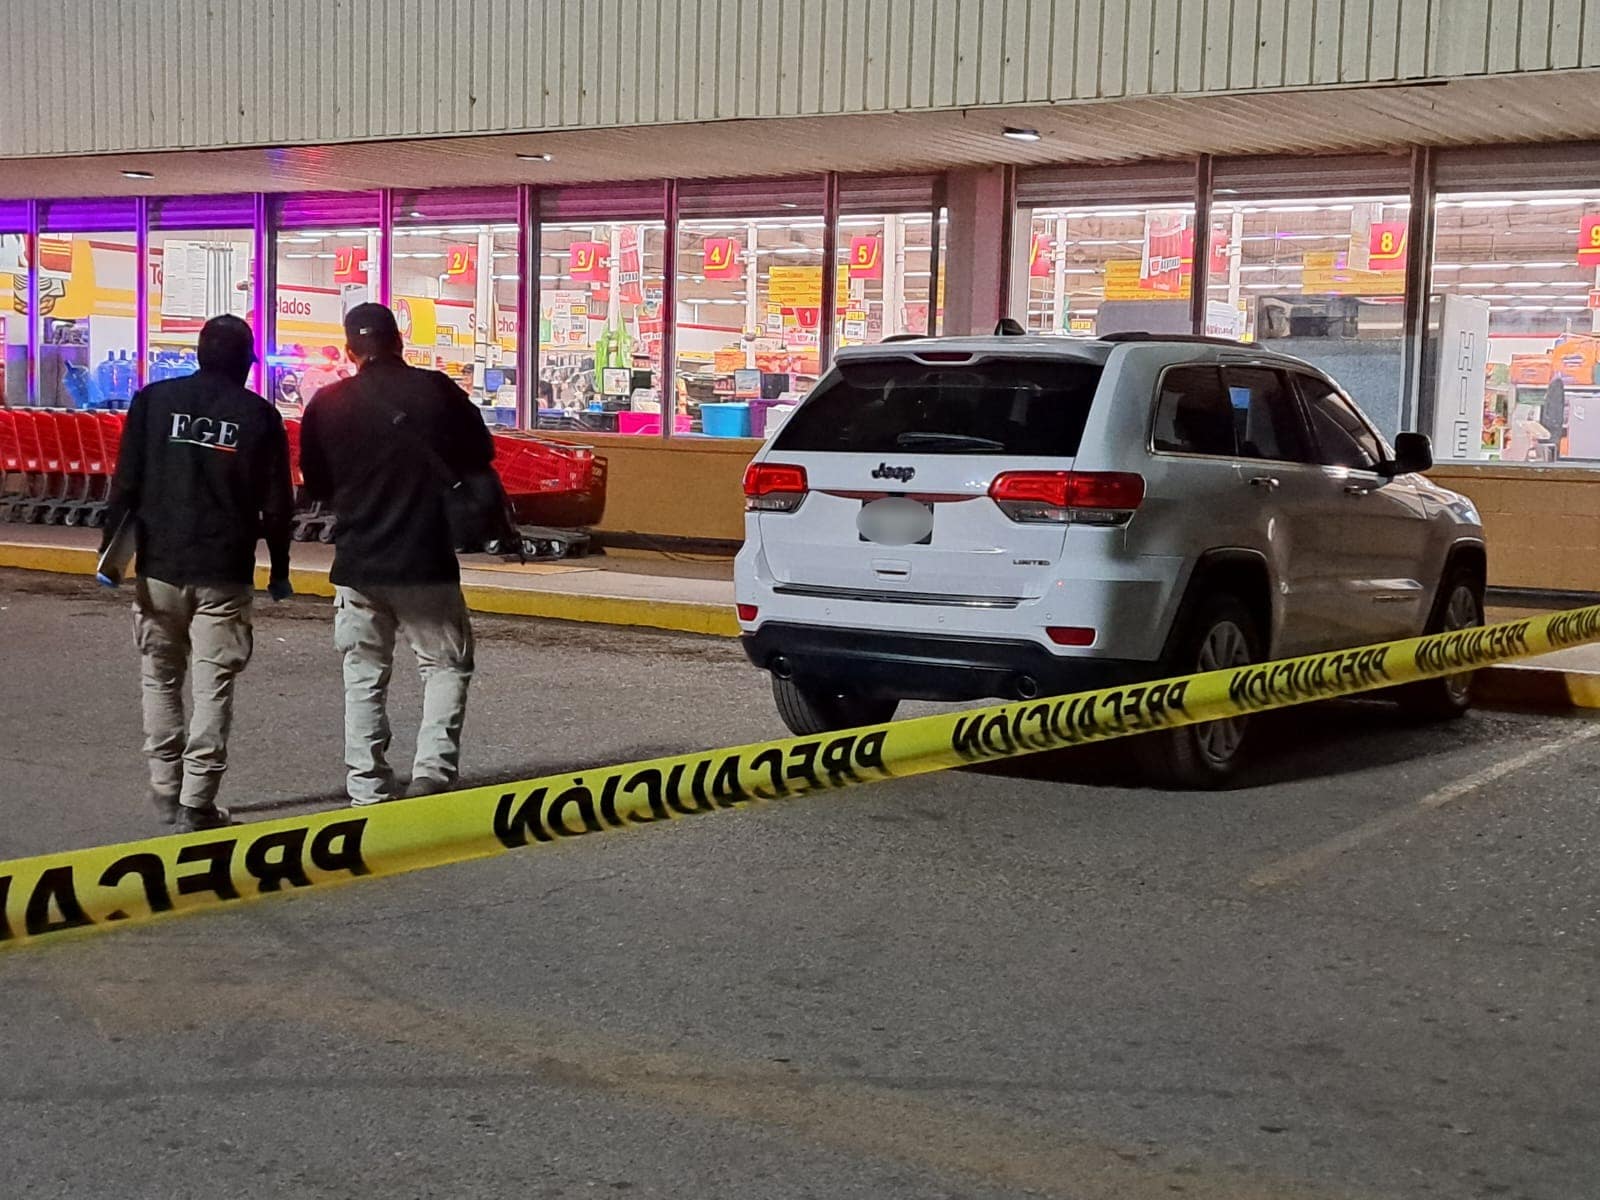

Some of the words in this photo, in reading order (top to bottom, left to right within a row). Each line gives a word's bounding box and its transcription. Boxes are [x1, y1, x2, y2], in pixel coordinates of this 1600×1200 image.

[1381, 231, 1393, 252] 8
[1591, 225, 1600, 246] 9
[339, 255, 344, 270] 1
[453, 252, 461, 269] 2
[578, 250, 586, 266] 3
[711, 246, 721, 263] 4
[857, 245, 868, 263] 5
[804, 310, 811, 324] 1
[168, 412, 240, 448] FGE
[871, 462, 916, 483] Jeep
